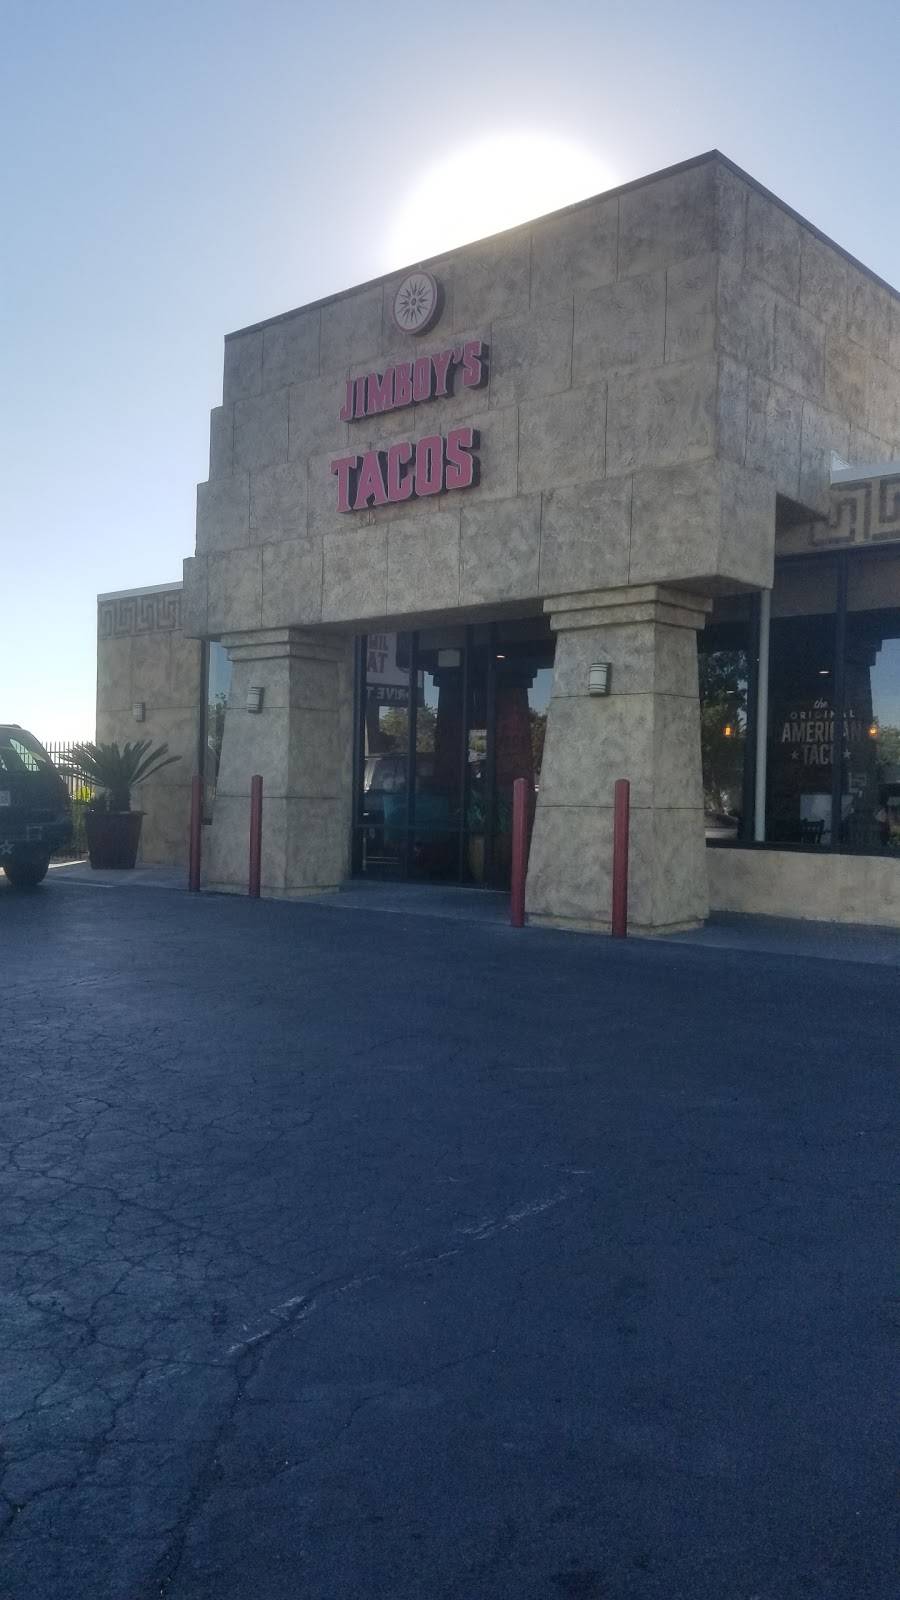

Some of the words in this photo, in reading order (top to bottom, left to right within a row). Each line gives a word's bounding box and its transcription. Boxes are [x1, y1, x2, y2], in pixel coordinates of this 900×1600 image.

[338, 340, 484, 422] JIMBOY'S
[330, 426, 476, 512] TACOS
[802, 744, 834, 766] TAC
